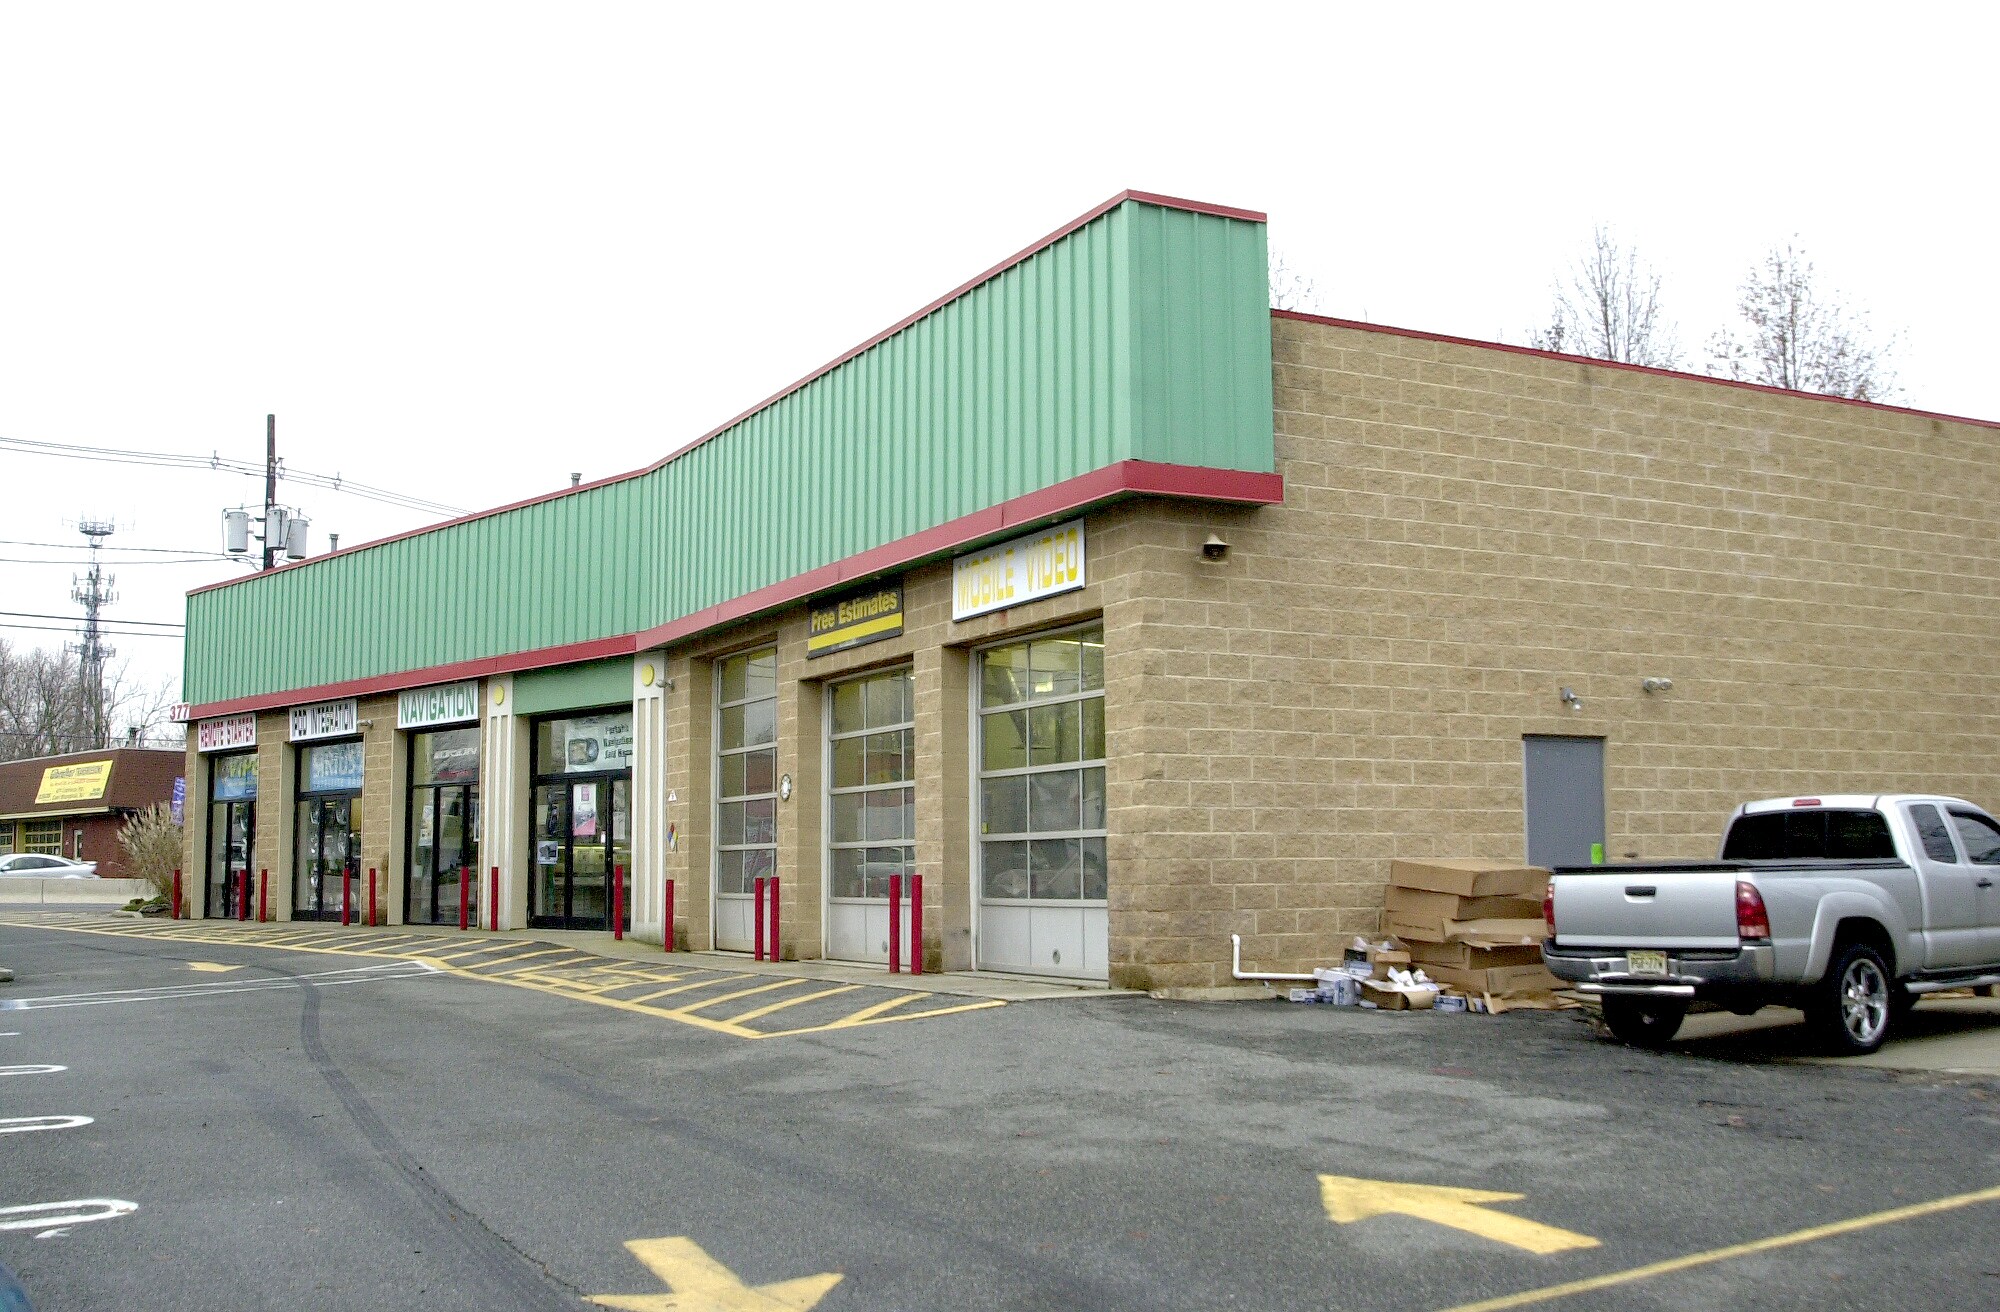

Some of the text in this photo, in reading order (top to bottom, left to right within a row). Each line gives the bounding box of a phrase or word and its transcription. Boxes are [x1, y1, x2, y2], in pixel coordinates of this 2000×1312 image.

[958, 528, 1078, 612] MOBILE VIDEO
[811, 592, 898, 633] Free Estimates
[169, 704, 189, 720] 377
[310, 702, 354, 735] INTEGRATION
[400, 685, 475, 725] NAVIGATION
